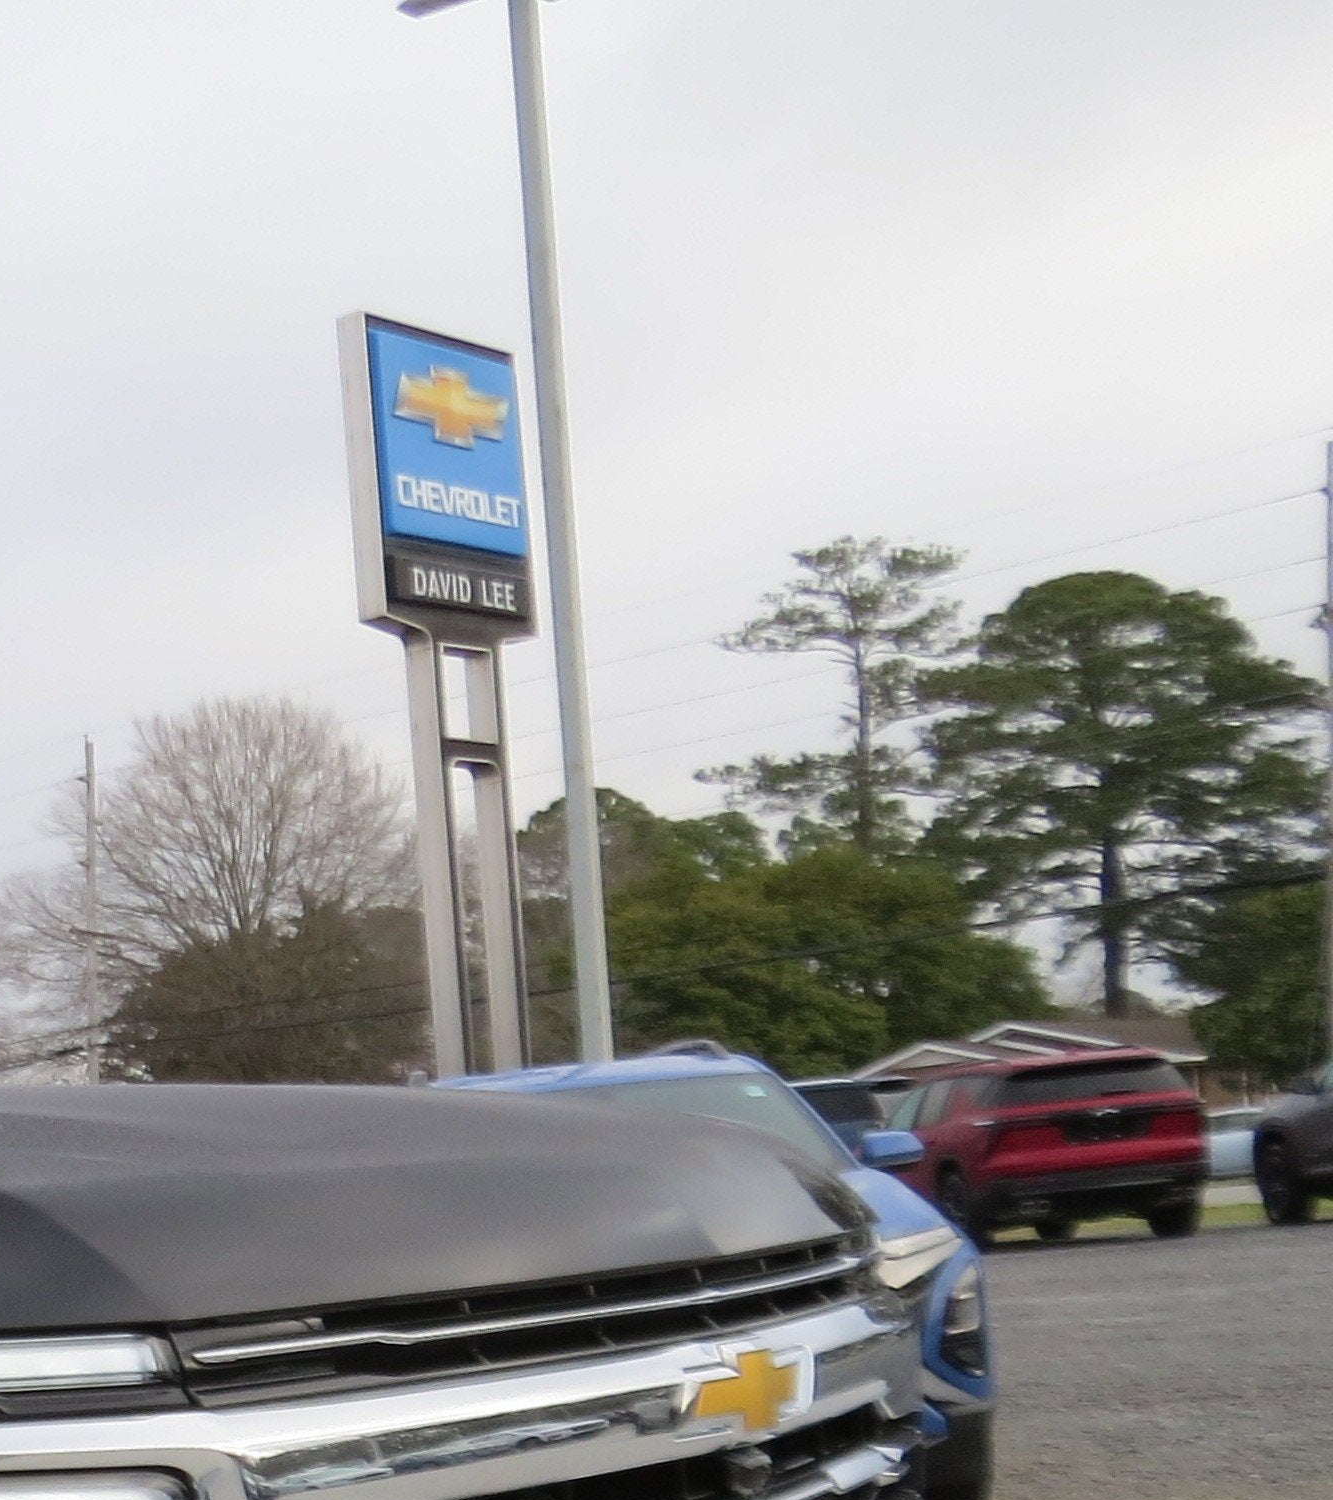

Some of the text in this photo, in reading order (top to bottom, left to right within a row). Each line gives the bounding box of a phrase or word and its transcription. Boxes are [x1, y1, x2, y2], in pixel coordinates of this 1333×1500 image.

[397, 475, 520, 528] CHEVROLET
[413, 567, 518, 612] DAVID LEE
